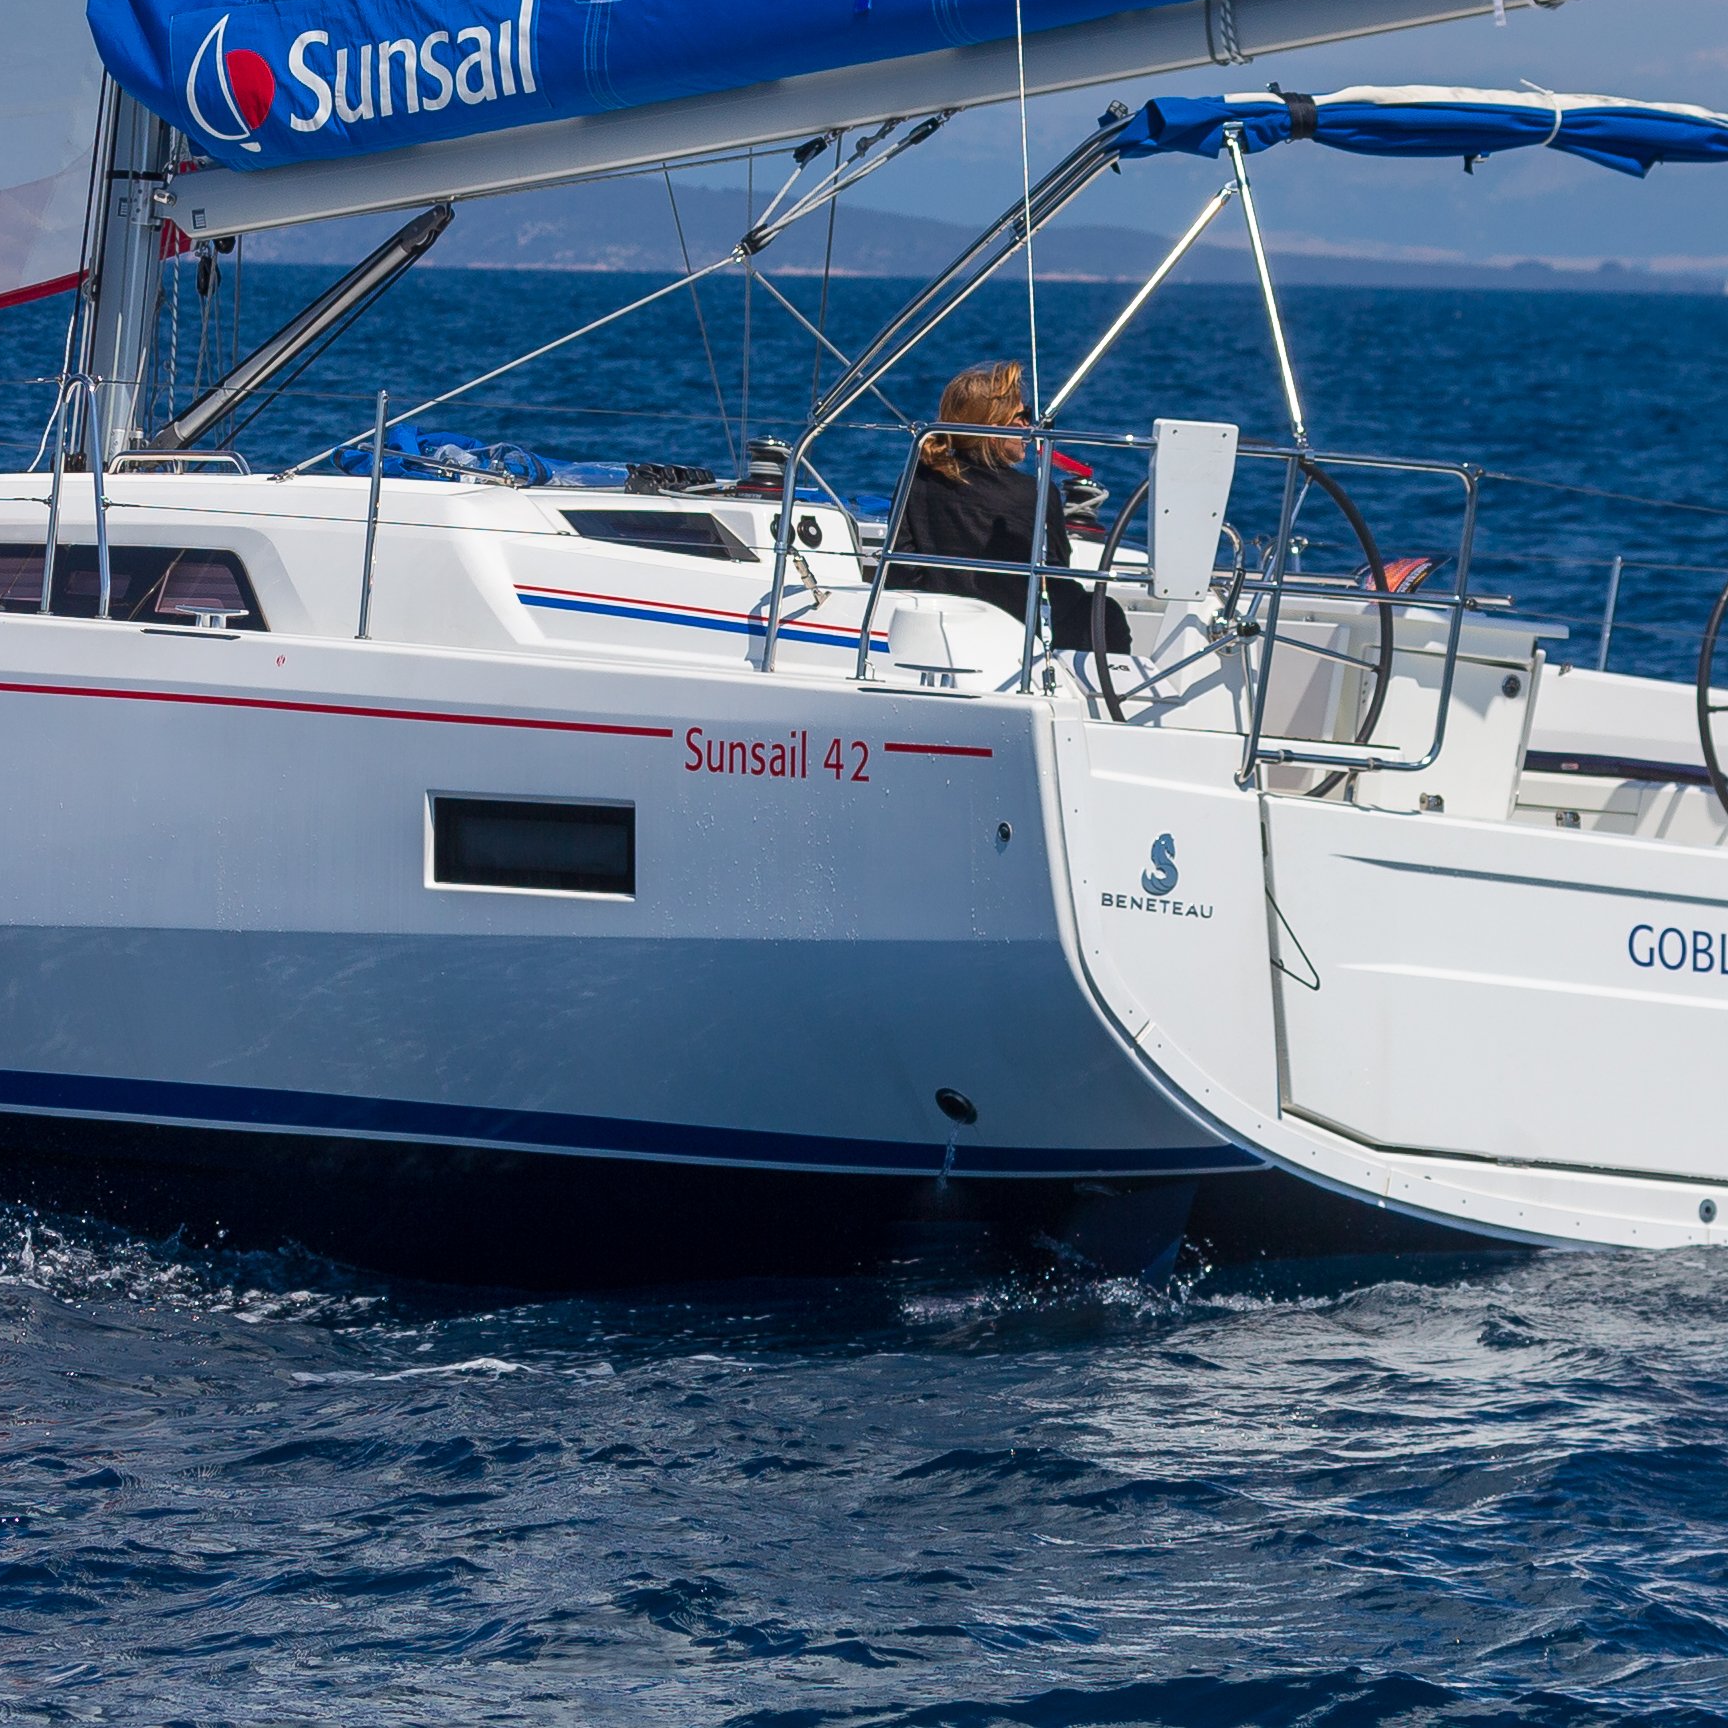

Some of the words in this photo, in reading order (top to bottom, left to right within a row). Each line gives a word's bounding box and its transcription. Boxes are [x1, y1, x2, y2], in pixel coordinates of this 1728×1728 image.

[684, 726, 808, 779] Sunsail
[823, 737, 871, 783] 42
[1100, 892, 1214, 919] BENETEAU
